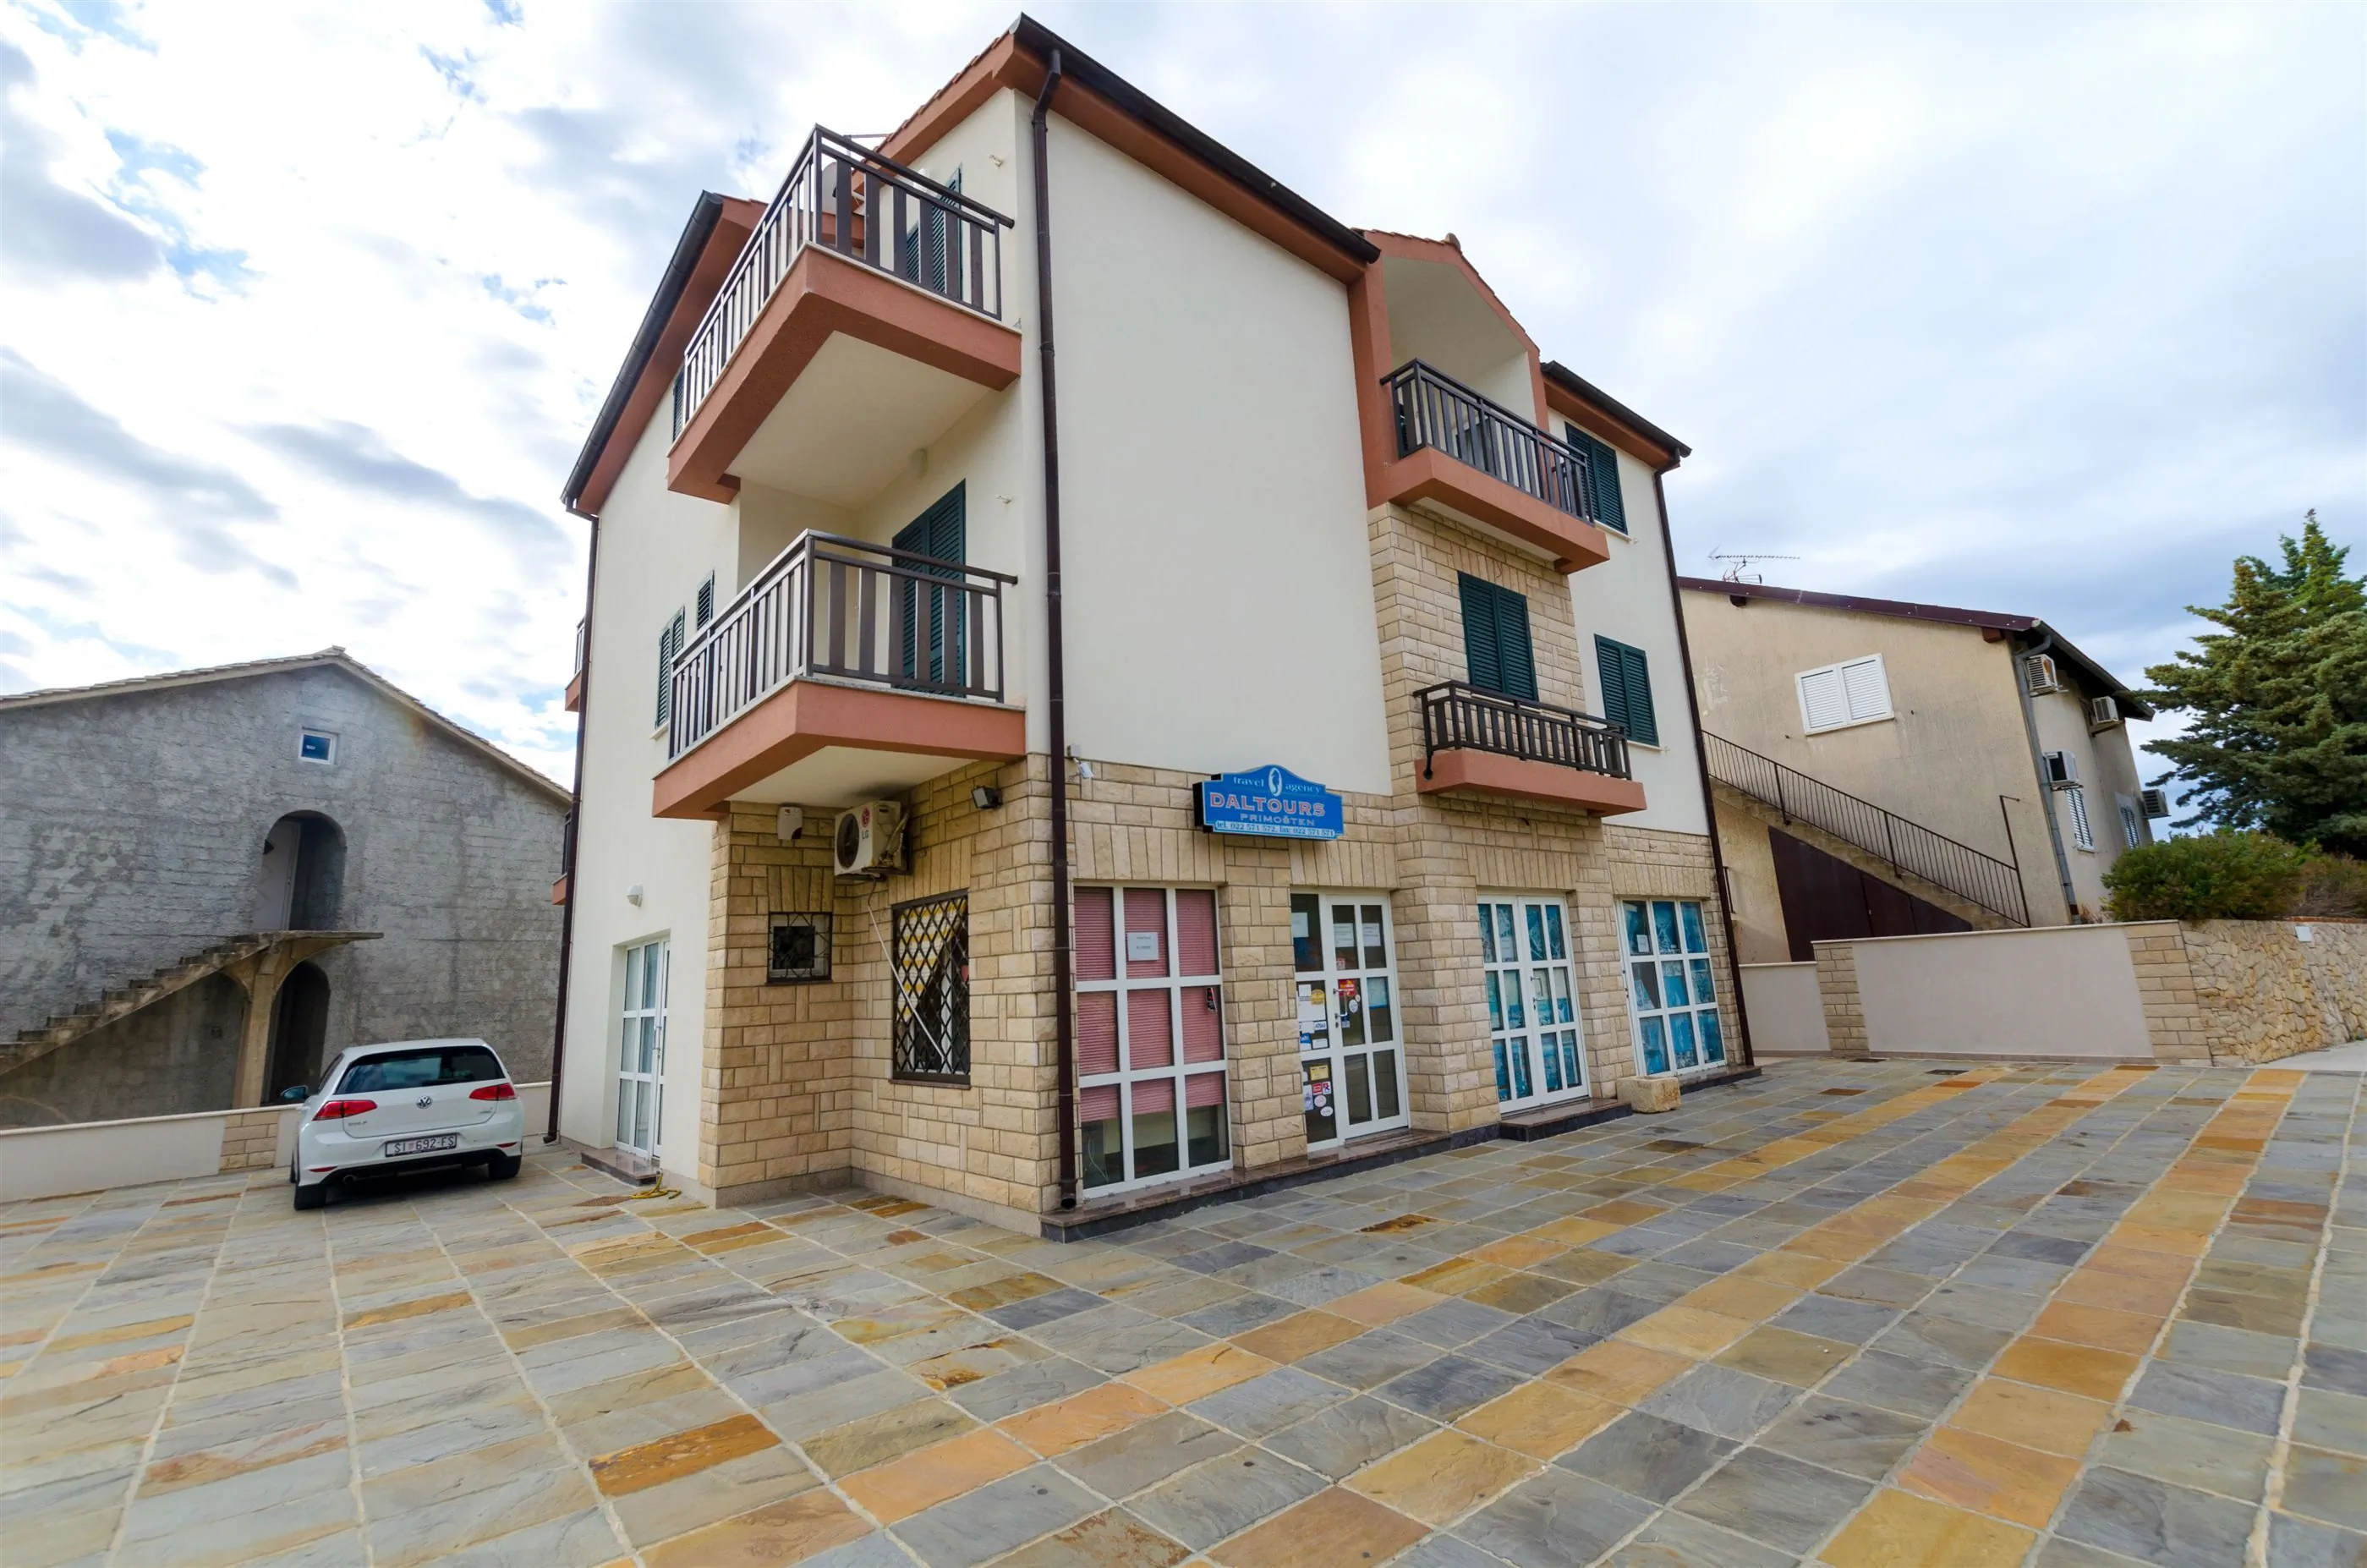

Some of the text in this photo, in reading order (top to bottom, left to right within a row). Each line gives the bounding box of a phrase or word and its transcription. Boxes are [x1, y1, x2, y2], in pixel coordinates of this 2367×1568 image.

[1233, 776, 1322, 794] travel agency
[1210, 792, 1326, 817] DALTOURS
[1240, 813, 1315, 826] PRIMOŠTEN
[863, 830, 869, 839] LG
[394, 1136, 454, 1153] SI 692-FS
